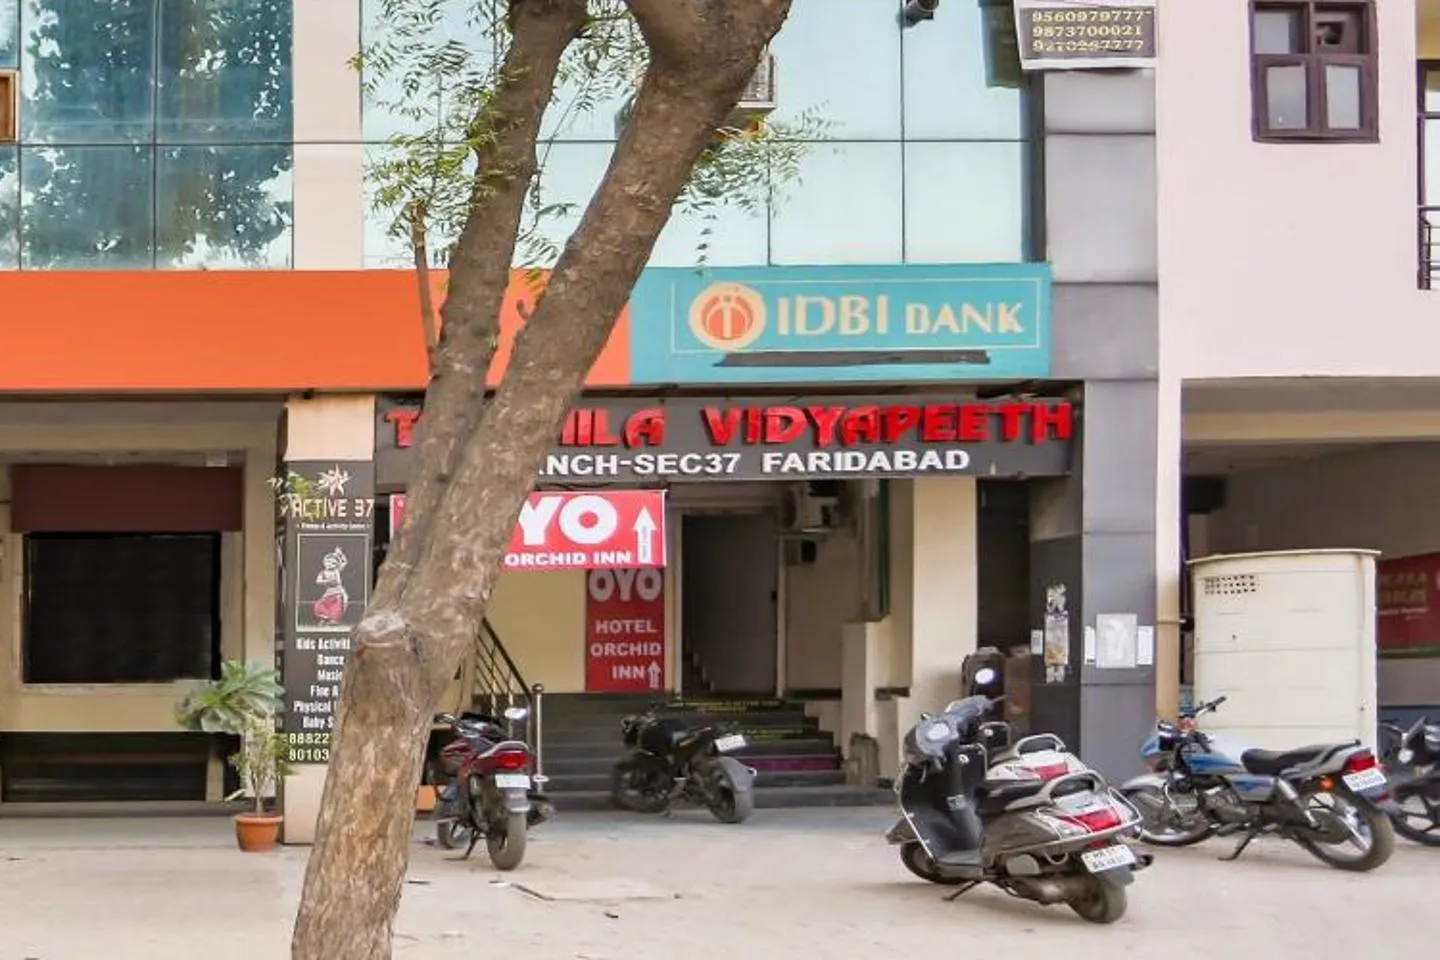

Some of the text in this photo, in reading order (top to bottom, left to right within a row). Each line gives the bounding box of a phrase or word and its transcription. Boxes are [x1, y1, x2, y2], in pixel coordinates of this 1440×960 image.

[777, 294, 1025, 336] IDBI BANK
[704, 403, 1072, 446] VIDYAPEETH
[539, 450, 971, 476] NCH-SEC37 FARIDABAD
[292, 497, 375, 518] ACTIVE 37
[518, 495, 618, 545] YO
[504, 550, 632, 567] ORCHID INN
[589, 568, 661, 602] OYO
[595, 620, 657, 634] HOTEL
[590, 642, 661, 657] ORCHID
[612, 665, 646, 679] INN
